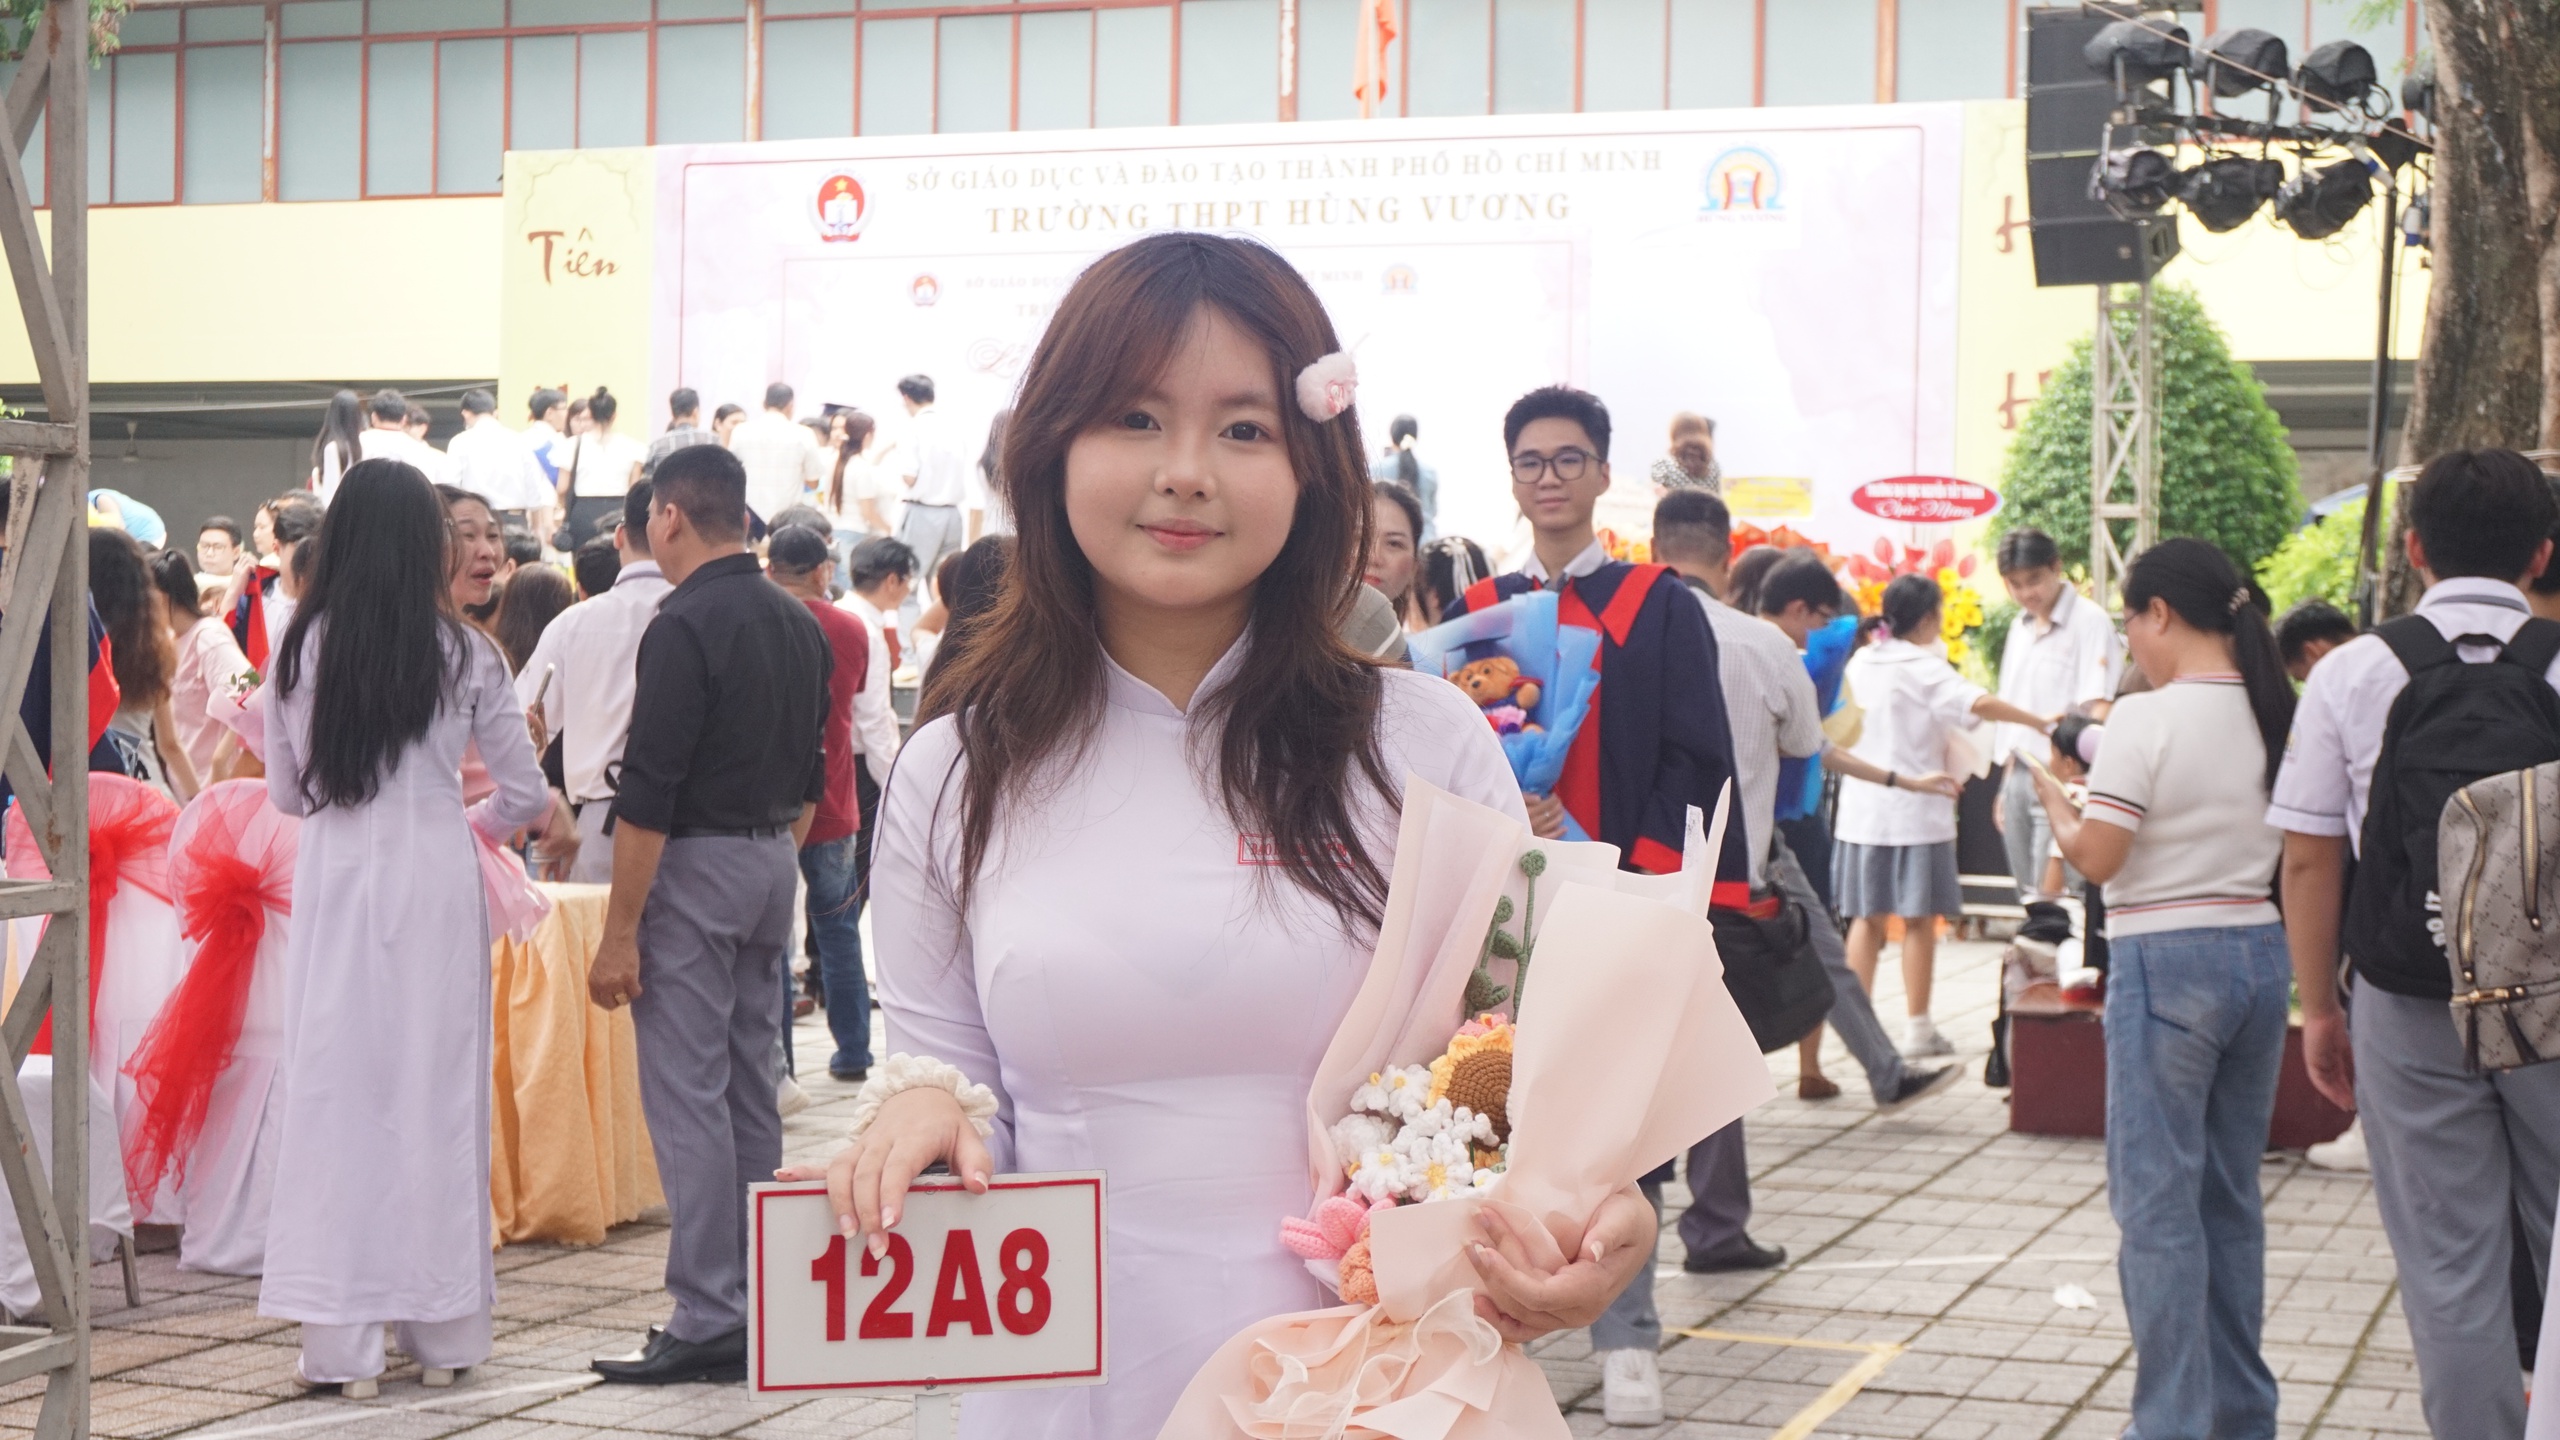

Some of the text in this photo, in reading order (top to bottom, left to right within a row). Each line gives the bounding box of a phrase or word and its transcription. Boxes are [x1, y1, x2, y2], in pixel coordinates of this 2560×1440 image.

[906, 147, 1662, 191] SỞ GIÁO DỤC VÀ ĐÀO TẠO THÀNH PHỐ HỒ CHÍ MINH
[985, 190, 1570, 233] TRƯỜNG THPT HÙNG VƯƠNG
[527, 227, 621, 286] Tiên
[811, 1227, 1052, 1342] 12A8
